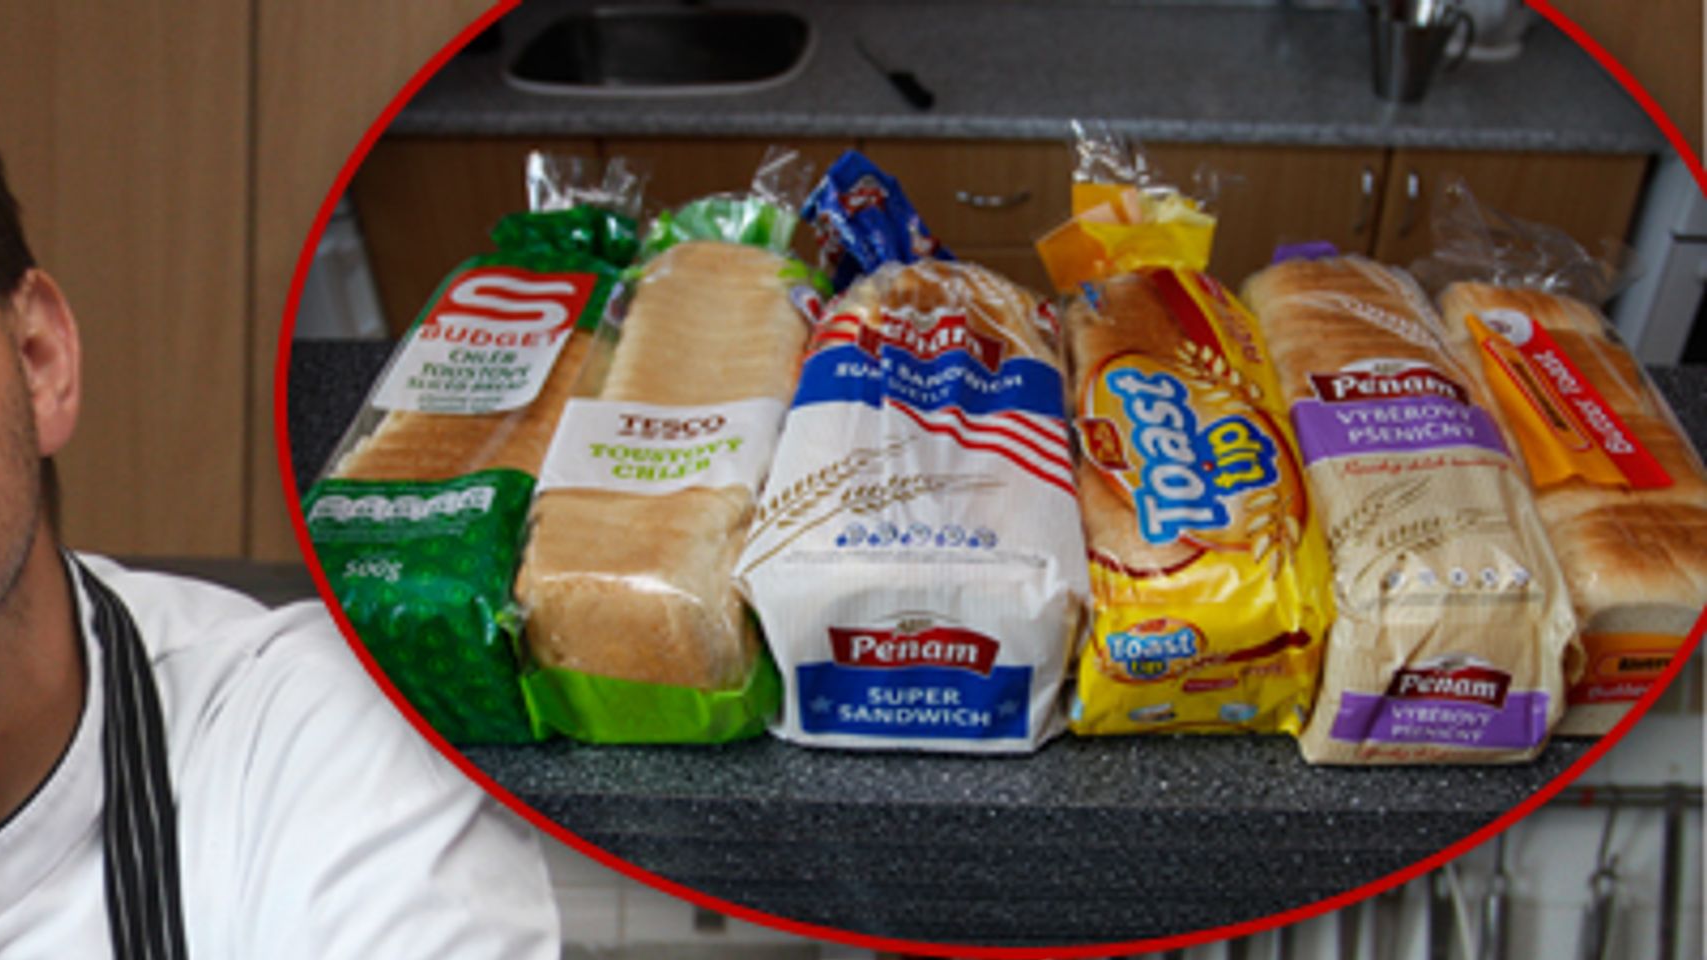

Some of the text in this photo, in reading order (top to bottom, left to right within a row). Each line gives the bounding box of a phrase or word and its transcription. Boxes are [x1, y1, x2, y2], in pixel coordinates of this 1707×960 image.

[418, 324, 564, 347] BUDGET
[1332, 376, 1457, 400] Penam
[616, 413, 727, 439] TESCO
[1114, 373, 1265, 537] Toast tip
[848, 635, 980, 664] Penam
[1112, 632, 1193, 659] Toast
[867, 685, 963, 706] SUPER
[1399, 674, 1499, 700] Penam
[837, 703, 992, 728] SANDWICH
